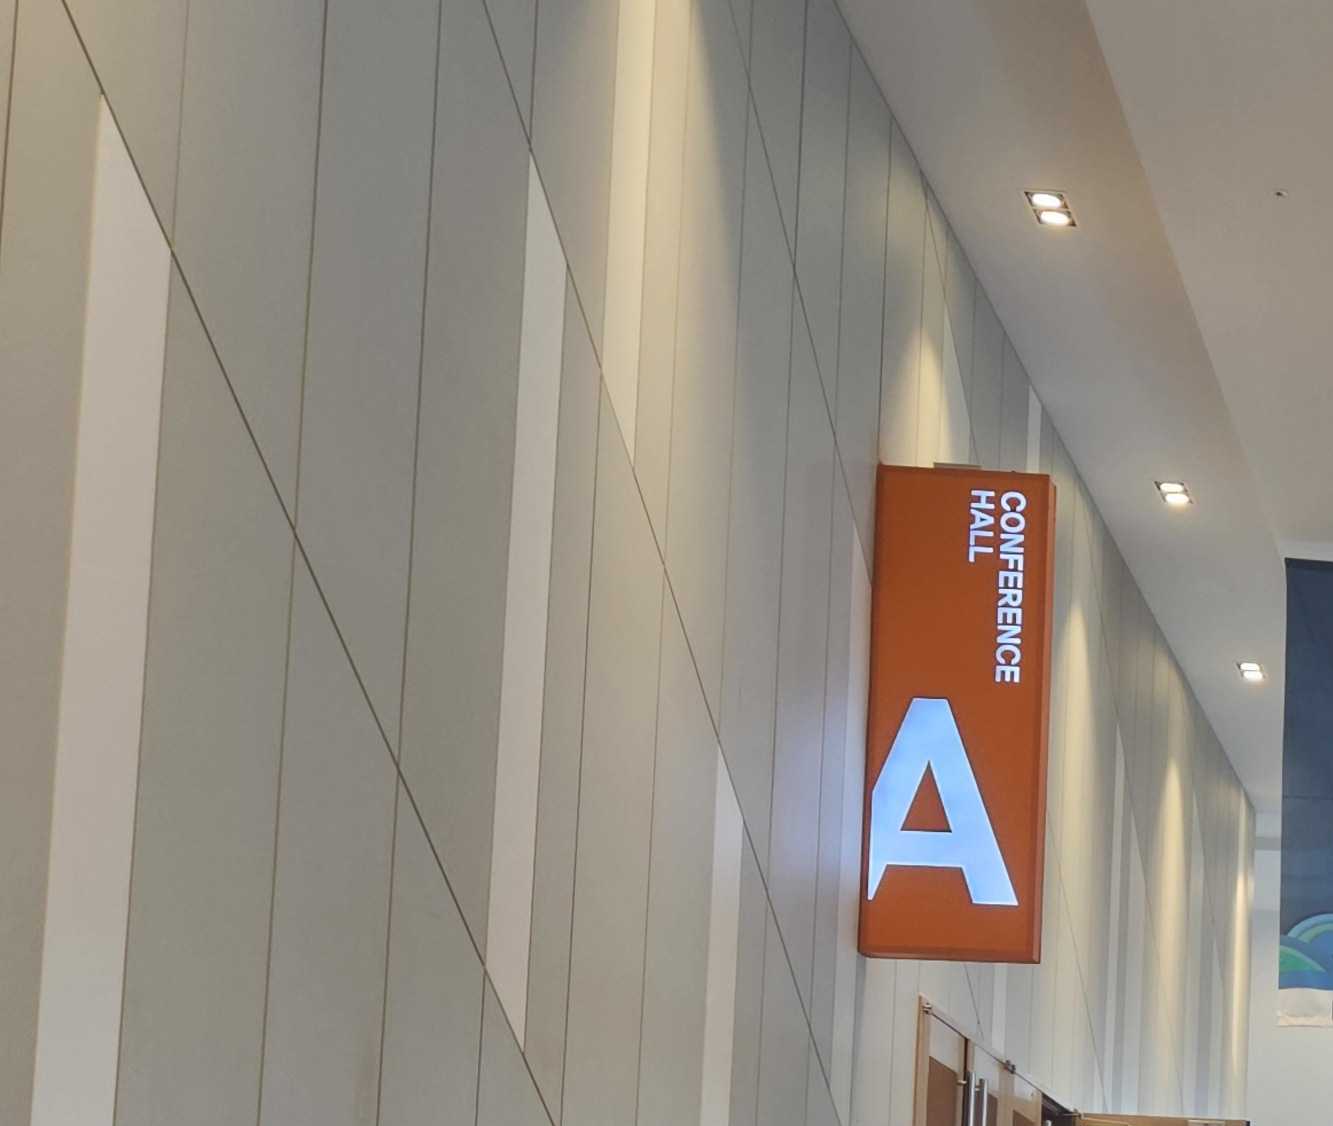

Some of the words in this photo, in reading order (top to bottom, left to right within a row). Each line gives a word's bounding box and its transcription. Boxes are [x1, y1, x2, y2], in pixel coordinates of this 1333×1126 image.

[968, 489, 995, 563] HALL
[995, 491, 1027, 683] CONFERENCE
[868, 697, 1019, 906] A
